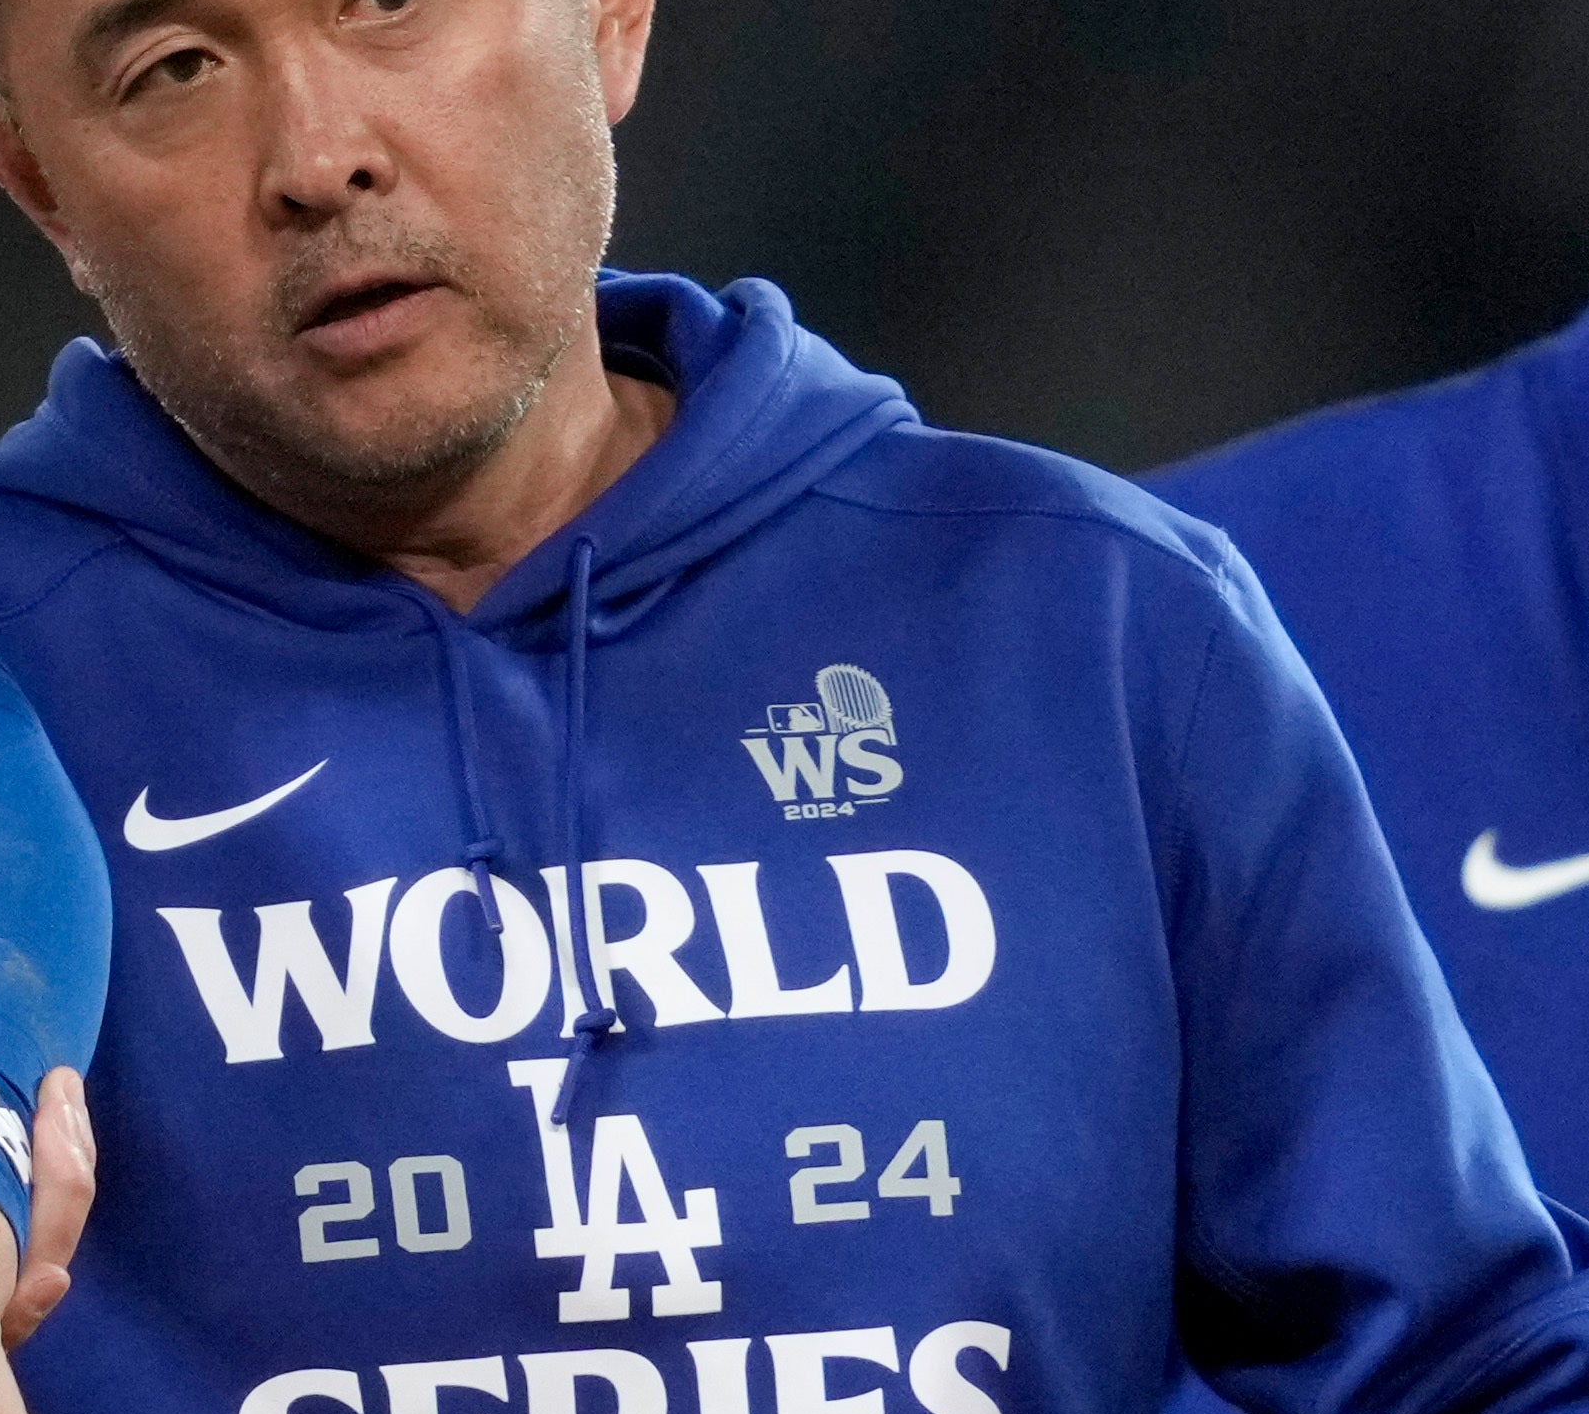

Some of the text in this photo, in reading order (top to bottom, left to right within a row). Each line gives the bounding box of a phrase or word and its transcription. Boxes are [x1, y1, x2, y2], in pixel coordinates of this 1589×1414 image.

[739, 728, 904, 802] WS
[783, 801, 856, 821] 2024
[156, 849, 998, 1065] WORLD
[293, 1057, 962, 1324] 20 LA 24
